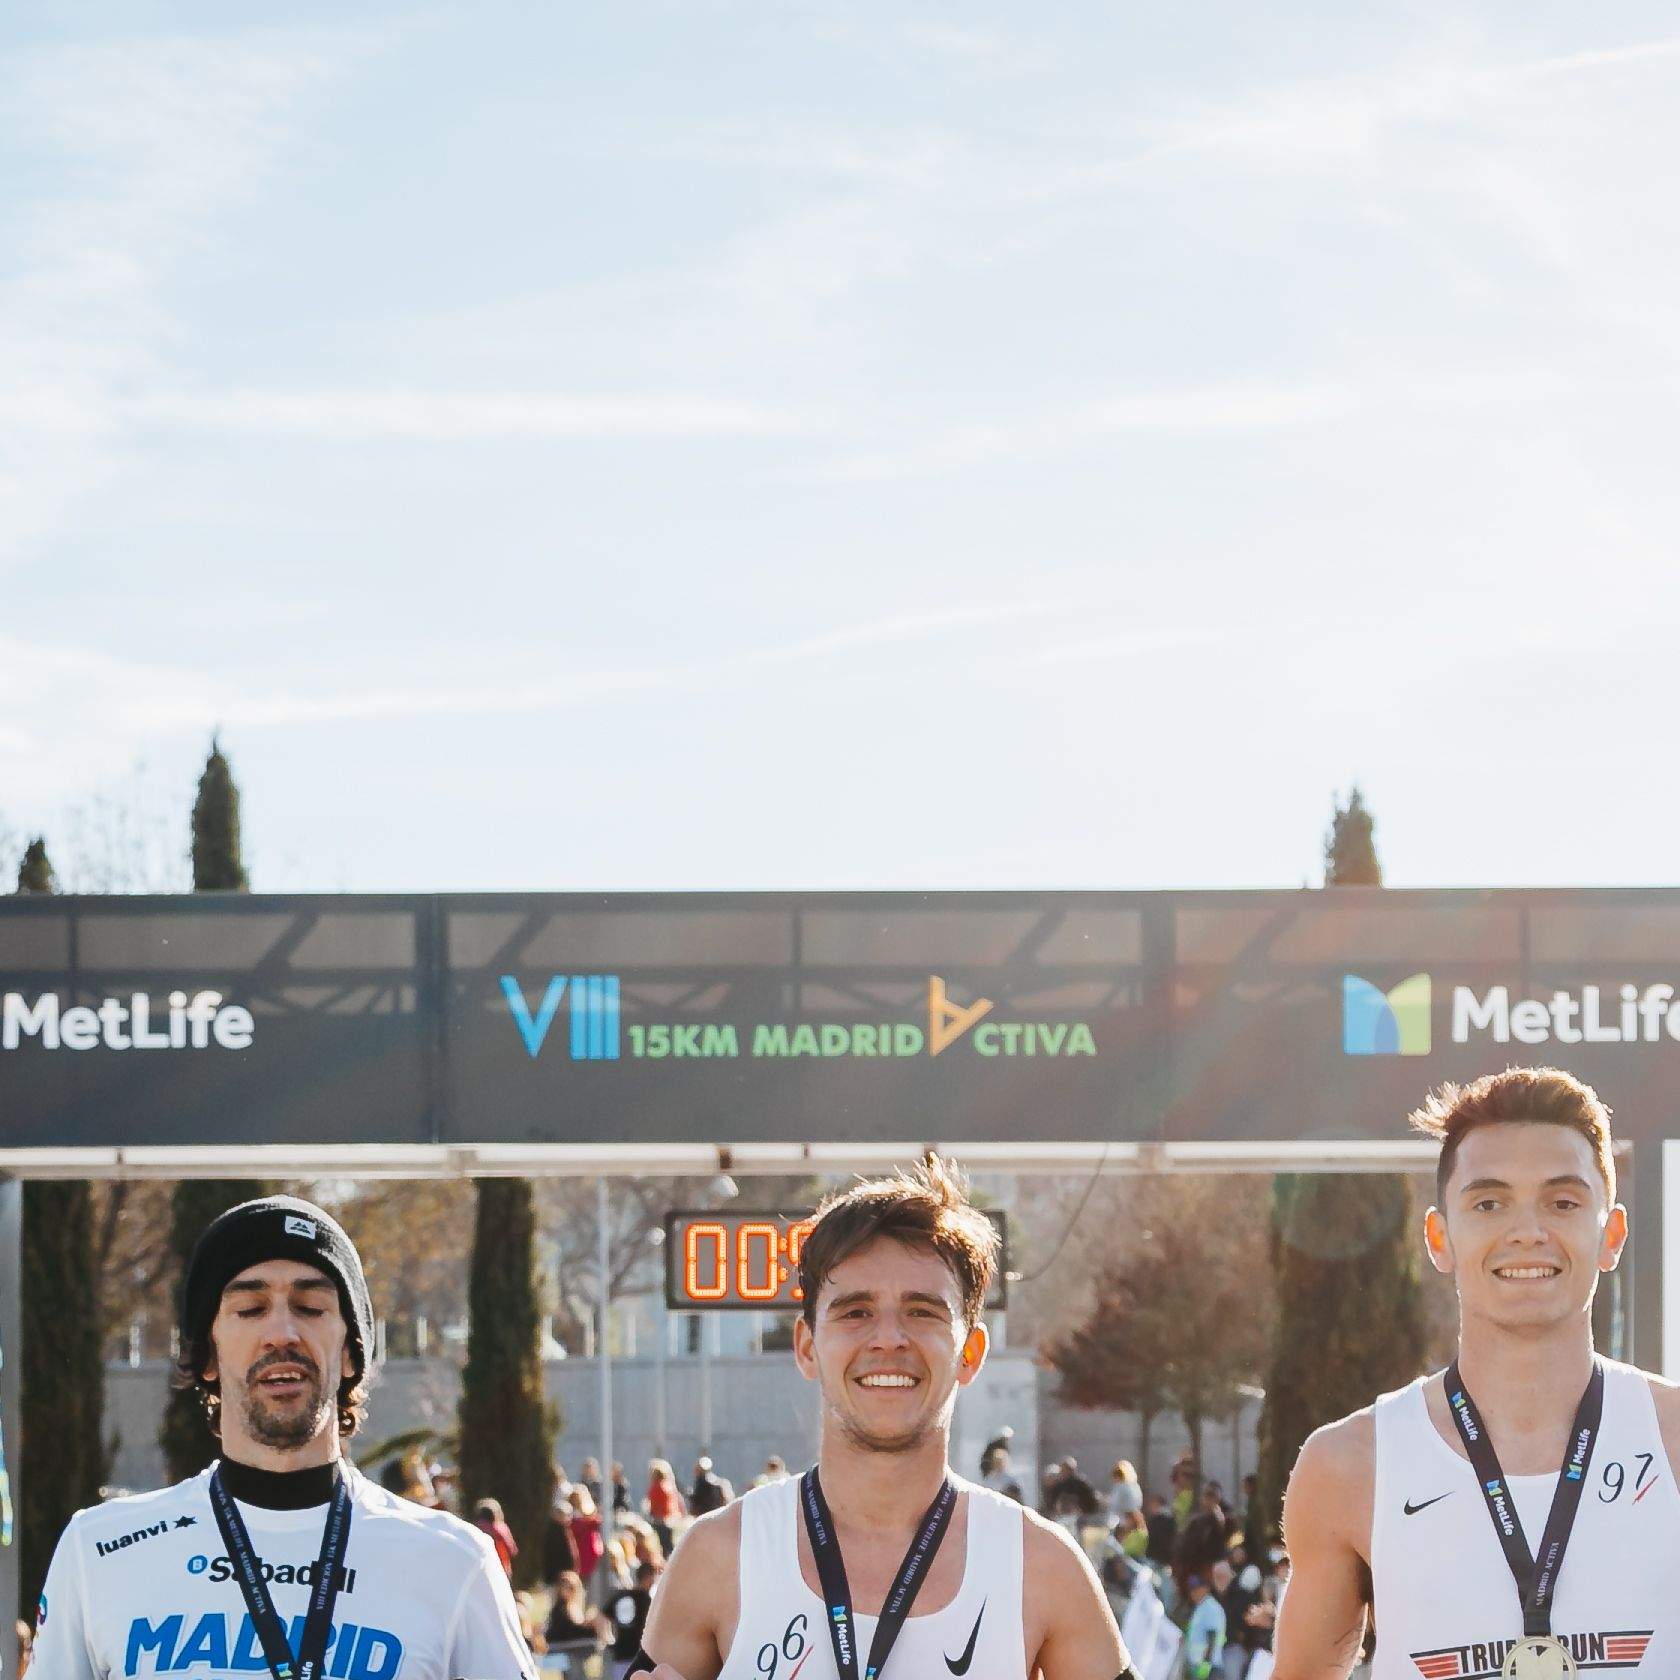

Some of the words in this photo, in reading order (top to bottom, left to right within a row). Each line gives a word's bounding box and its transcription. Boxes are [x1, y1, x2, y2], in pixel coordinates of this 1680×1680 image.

[1, 990, 255, 1051] MetLife
[499, 975, 621, 1060] VIII
[627, 1023, 739, 1058] 15KM
[752, 1023, 924, 1058] MADRID
[1459, 1405, 1477, 1441] MetLife
[1572, 1428, 1591, 1465] MetLife
[1598, 1452, 1654, 1503] 97
[1493, 1496, 1513, 1536] MetLife
[96, 1520, 168, 1557] luanvi
[209, 1557, 356, 1593] Sbadll
[835, 1623, 850, 1666] MetLife
